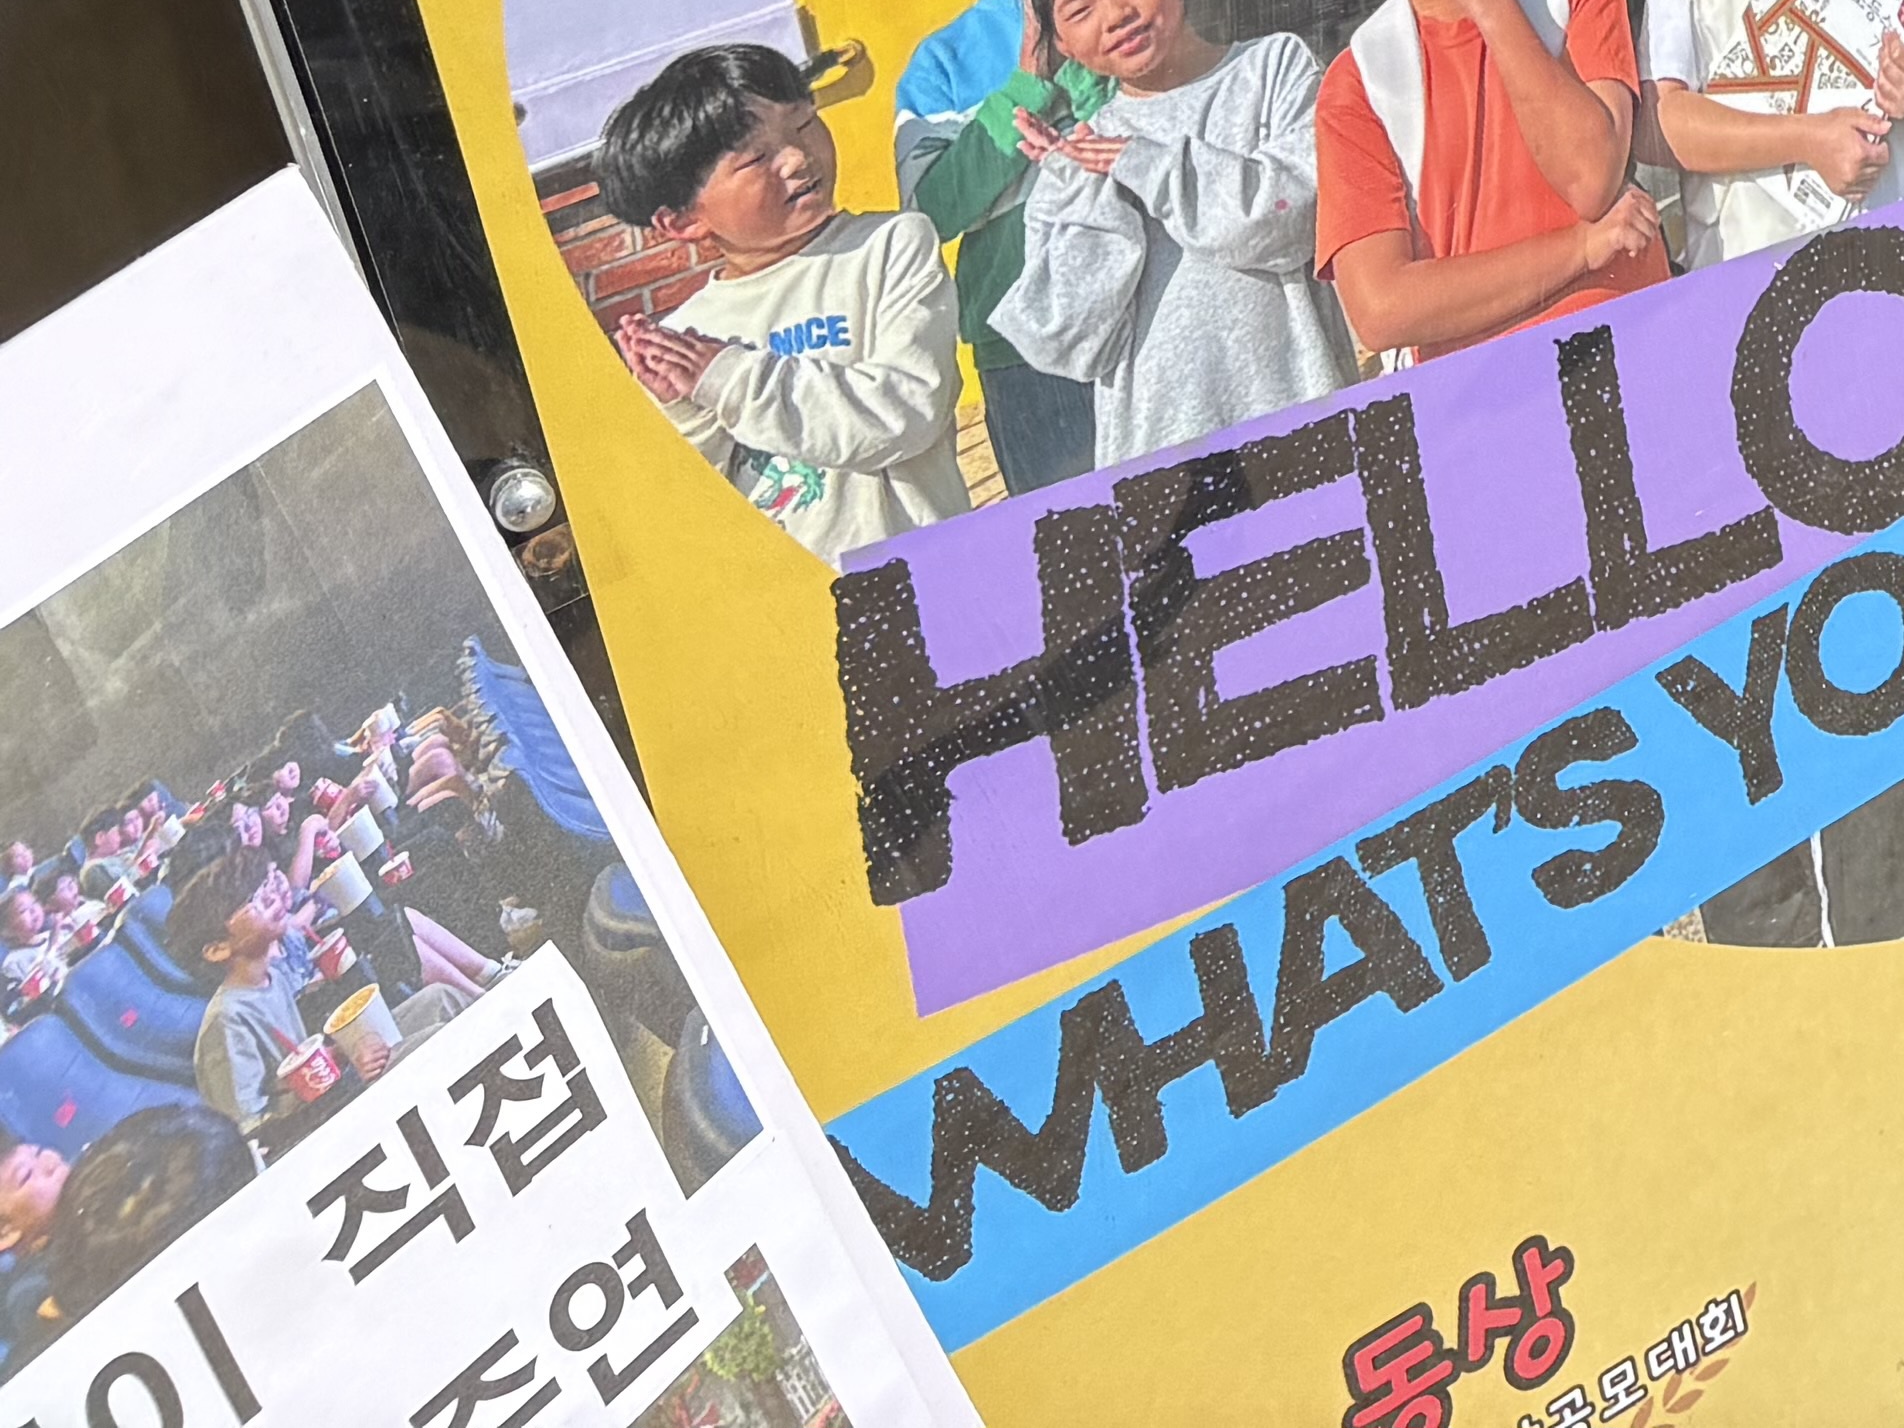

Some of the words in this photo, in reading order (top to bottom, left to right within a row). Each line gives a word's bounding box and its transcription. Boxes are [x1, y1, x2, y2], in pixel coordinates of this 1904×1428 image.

[768, 314, 852, 356] NICE
[826, 704, 1667, 1283] WHAT'S
[305, 997, 608, 1286] 직접
[1342, 1234, 1576, 1428] 동상
[1517, 1287, 1748, 1428] 공모대회
